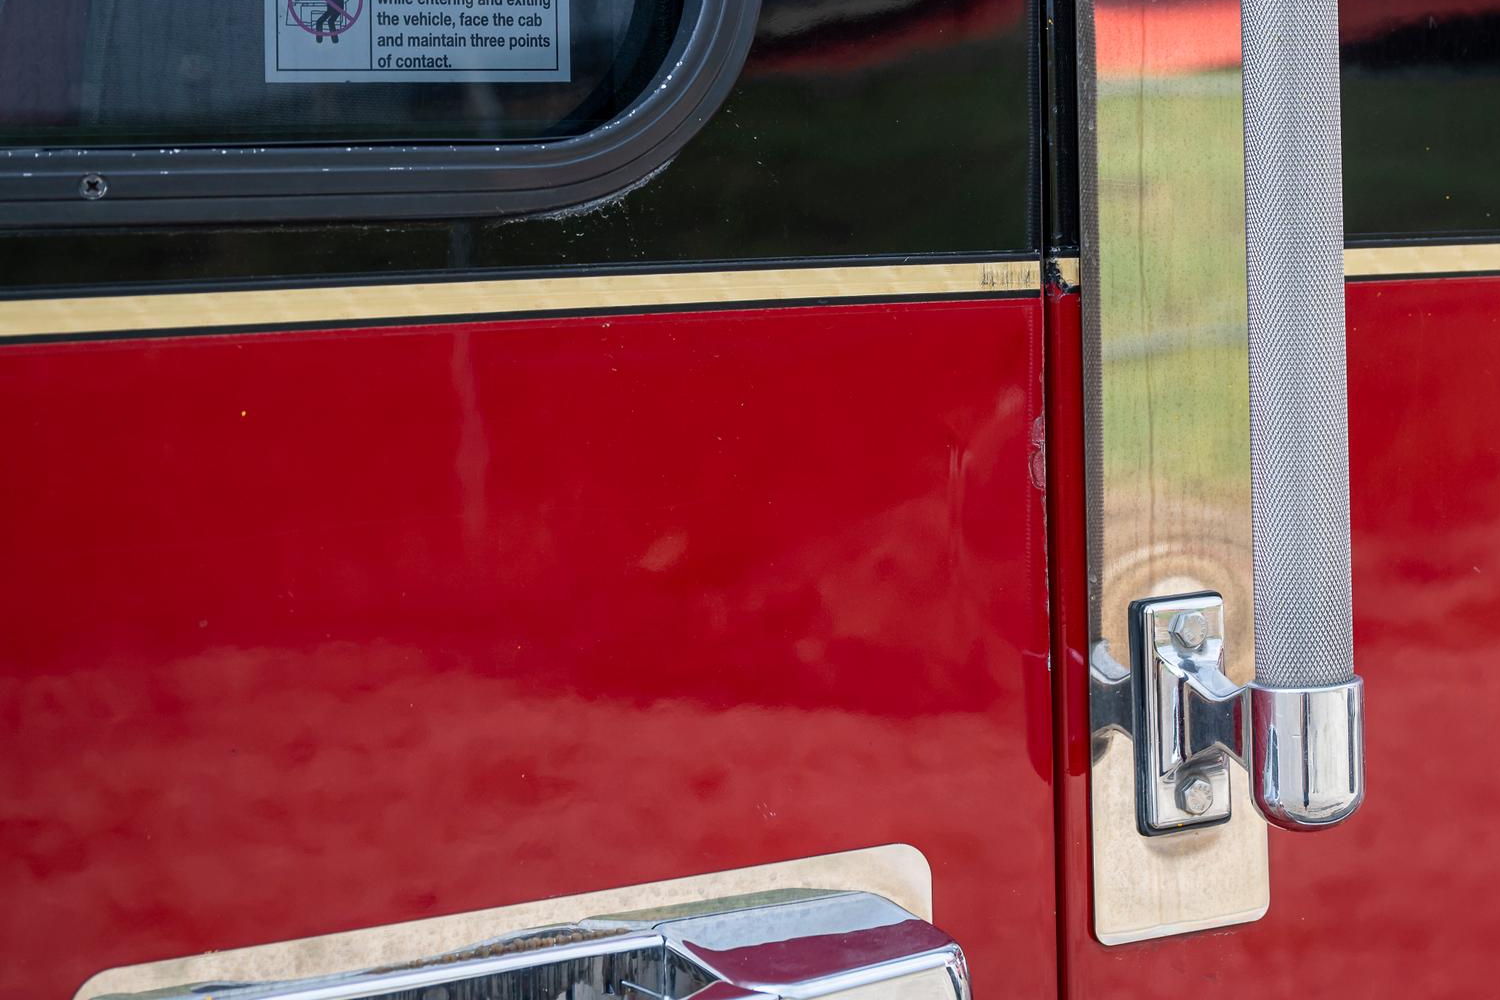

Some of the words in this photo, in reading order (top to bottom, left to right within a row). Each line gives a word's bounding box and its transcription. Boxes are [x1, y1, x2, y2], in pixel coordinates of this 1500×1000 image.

[377, 11, 399, 26] the
[403, 11, 456, 28] vehicle,
[459, 12, 489, 26] face
[493, 12, 515, 27] the
[518, 12, 542, 27] cab
[377, 33, 404, 47] and
[407, 33, 466, 47] maintain
[470, 32, 505, 47] three
[509, 33, 551, 50] points
[378, 54, 392, 68] of
[395, 55, 452, 69] contact.
